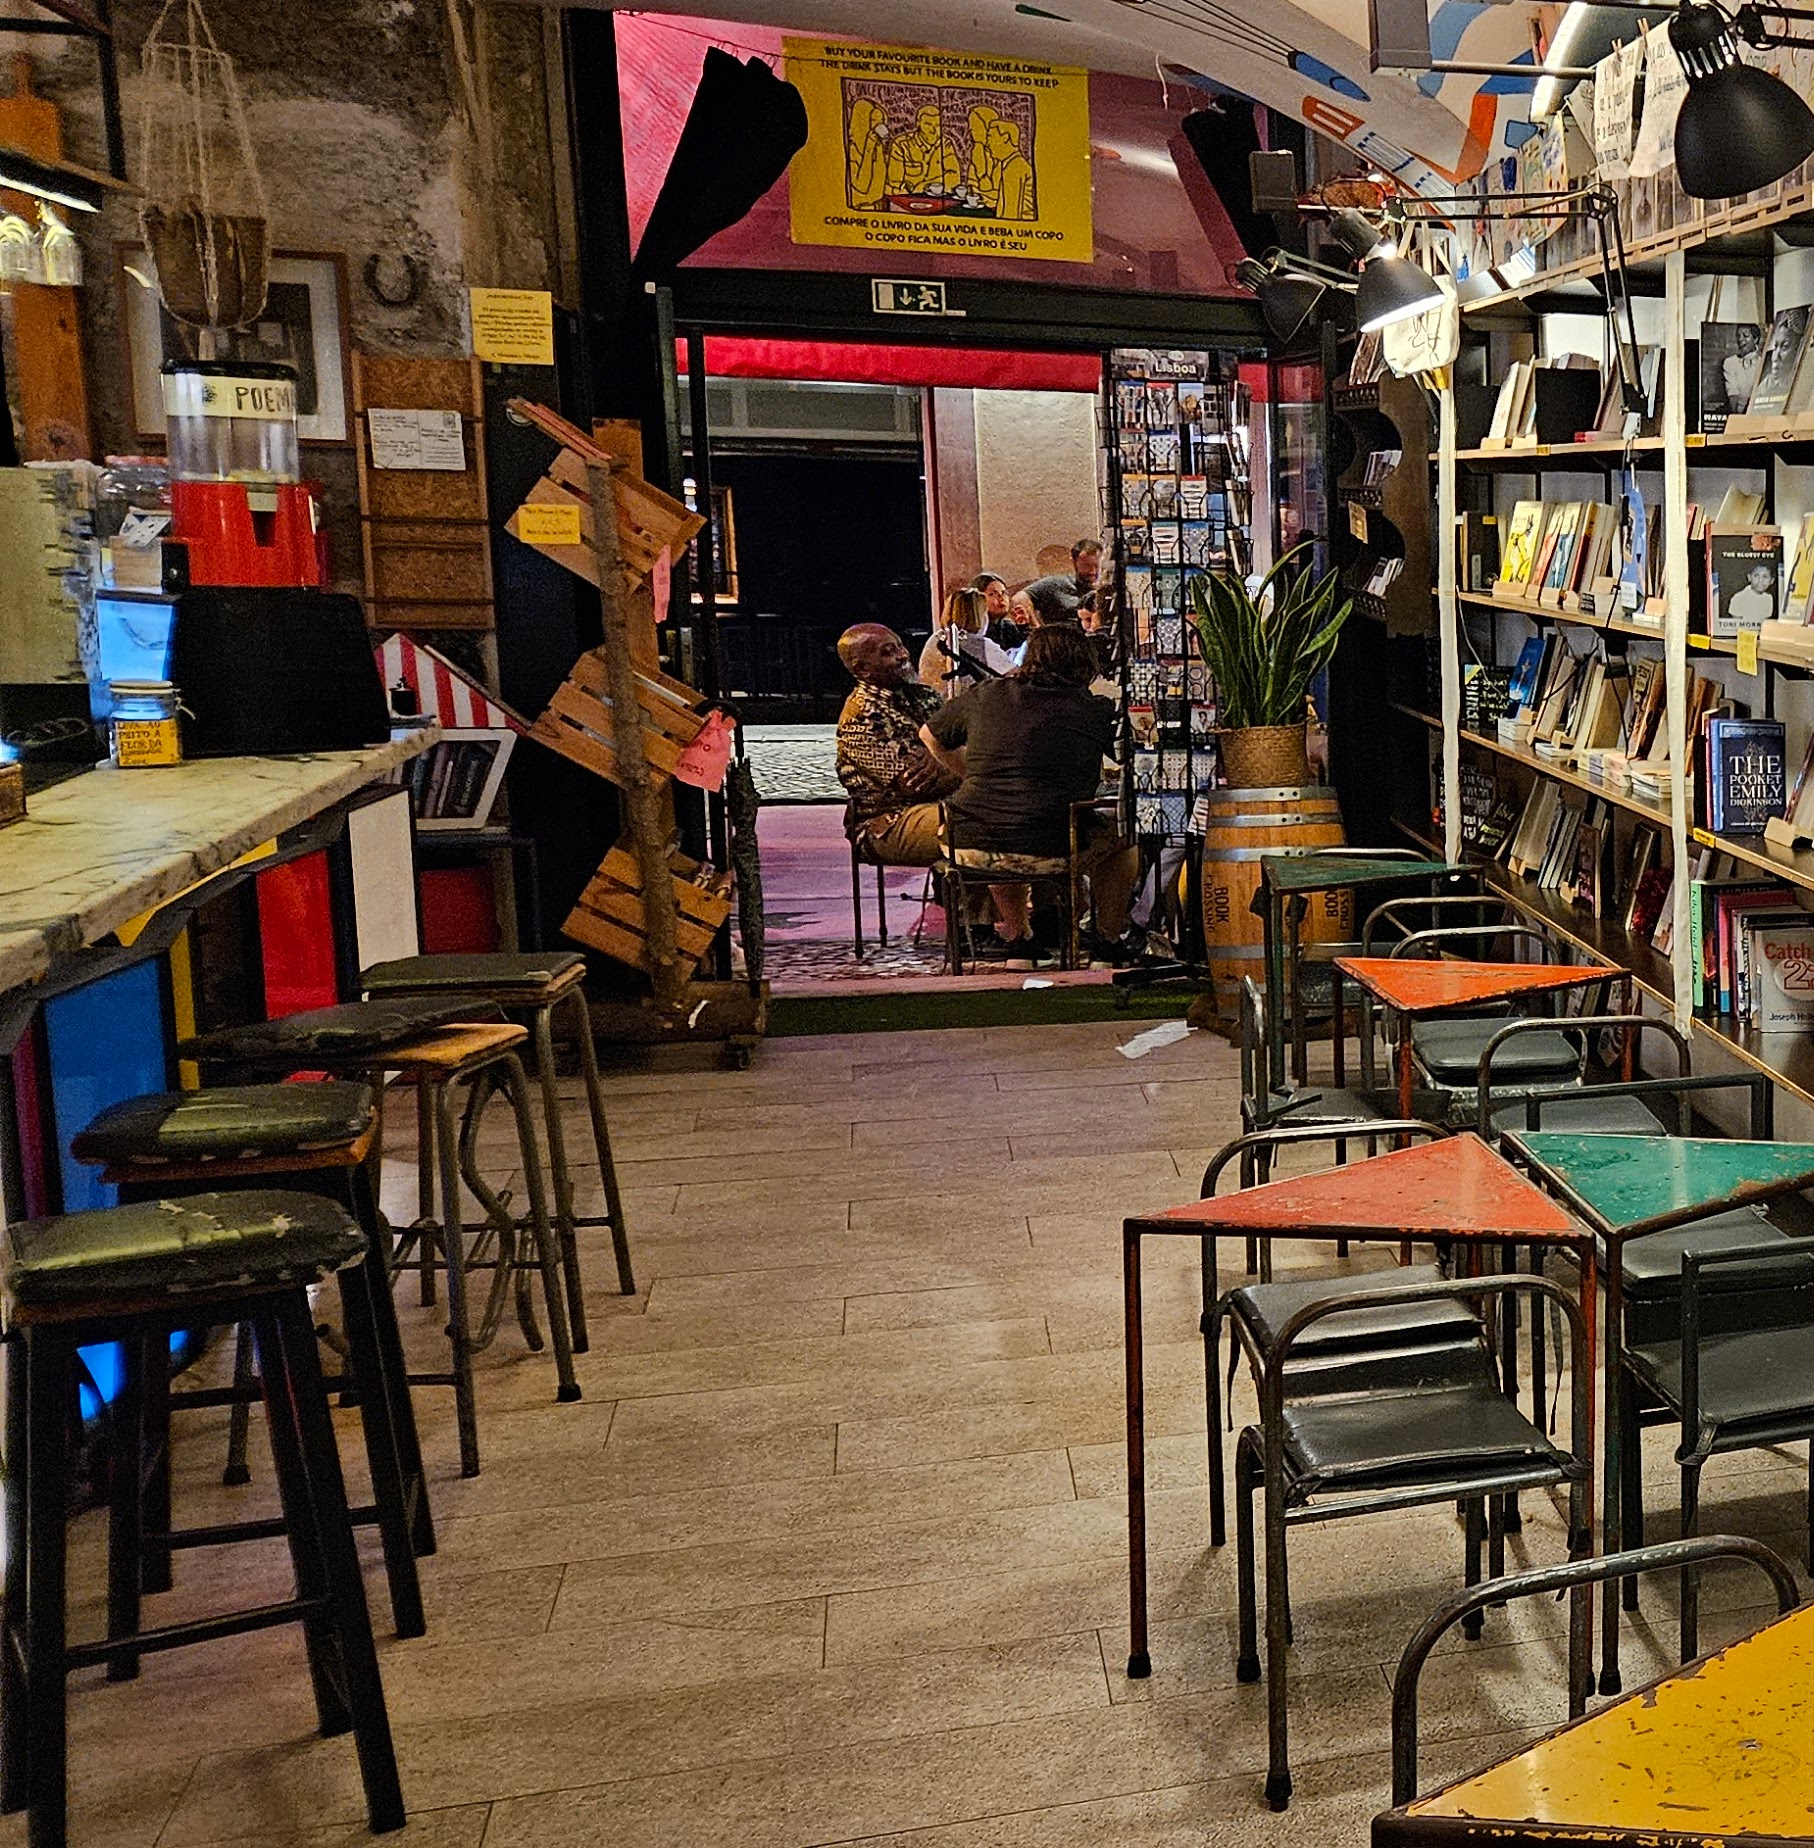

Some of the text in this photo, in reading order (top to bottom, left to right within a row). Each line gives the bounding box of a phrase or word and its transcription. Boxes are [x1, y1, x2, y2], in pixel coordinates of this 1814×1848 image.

[825, 46, 1053, 76] BUY YOUR FAVOURITE BOOK AND HAVE A DRINK
[820, 59, 1060, 90] THE DRINK STAYS BUT THE BOOK IS YOURS TO KEEP
[824, 215, 1064, 242] COMPRE O LIVRO DA SUA VIDA E BEBA UM COPO
[865, 232, 1028, 252] O COPO FICA MAS O LIVRO É SEU
[1155, 363, 1197, 376] Lisboa
[1718, 621, 1737, 629] TONI
[1729, 755, 1781, 775] THE
[1729, 774, 1783, 785] POCKET
[1730, 785, 1783, 799] EMILY
[1730, 798, 1783, 807] DICKINSON
[1213, 886, 1230, 924] BOOK
[1769, 1011, 1797, 1022] Joseph
